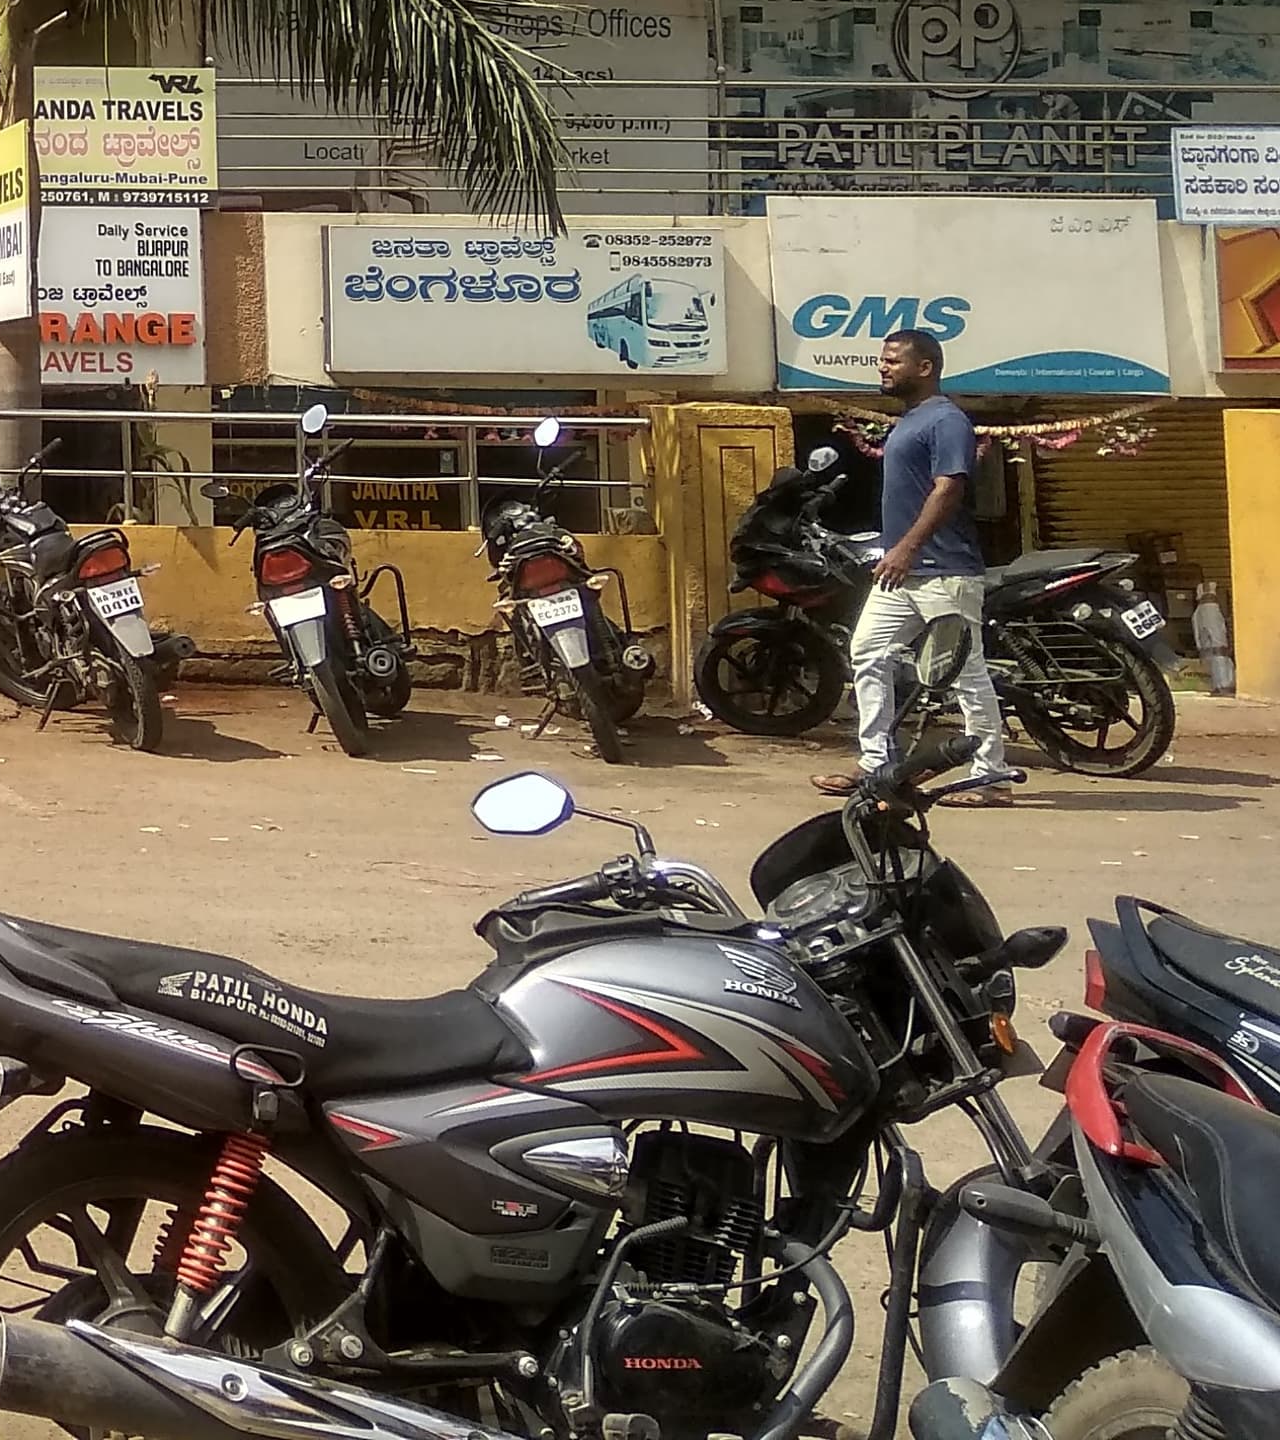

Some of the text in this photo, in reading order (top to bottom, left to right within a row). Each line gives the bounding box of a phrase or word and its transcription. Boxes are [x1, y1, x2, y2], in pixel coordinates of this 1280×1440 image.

[588, 8, 672, 39] Offices
[148, 73, 205, 96] VRL
[102, 100, 204, 122] TRAVELS
[776, 121, 1149, 169] PATIL PLANET
[124, 191, 210, 204] 9739715112
[98, 222, 189, 240] Daily Service
[604, 233, 714, 248] 08352-252972
[137, 239, 189, 257] BIJAPUR
[96, 258, 189, 278] TO BANGALORE
[791, 293, 972, 342] GMS
[190, 988, 258, 1016] BIJAPUR
[194, 970, 329, 1036] PATIL HONDA
[723, 978, 803, 1011] HONDA
[623, 1357, 703, 1371] HONDA
